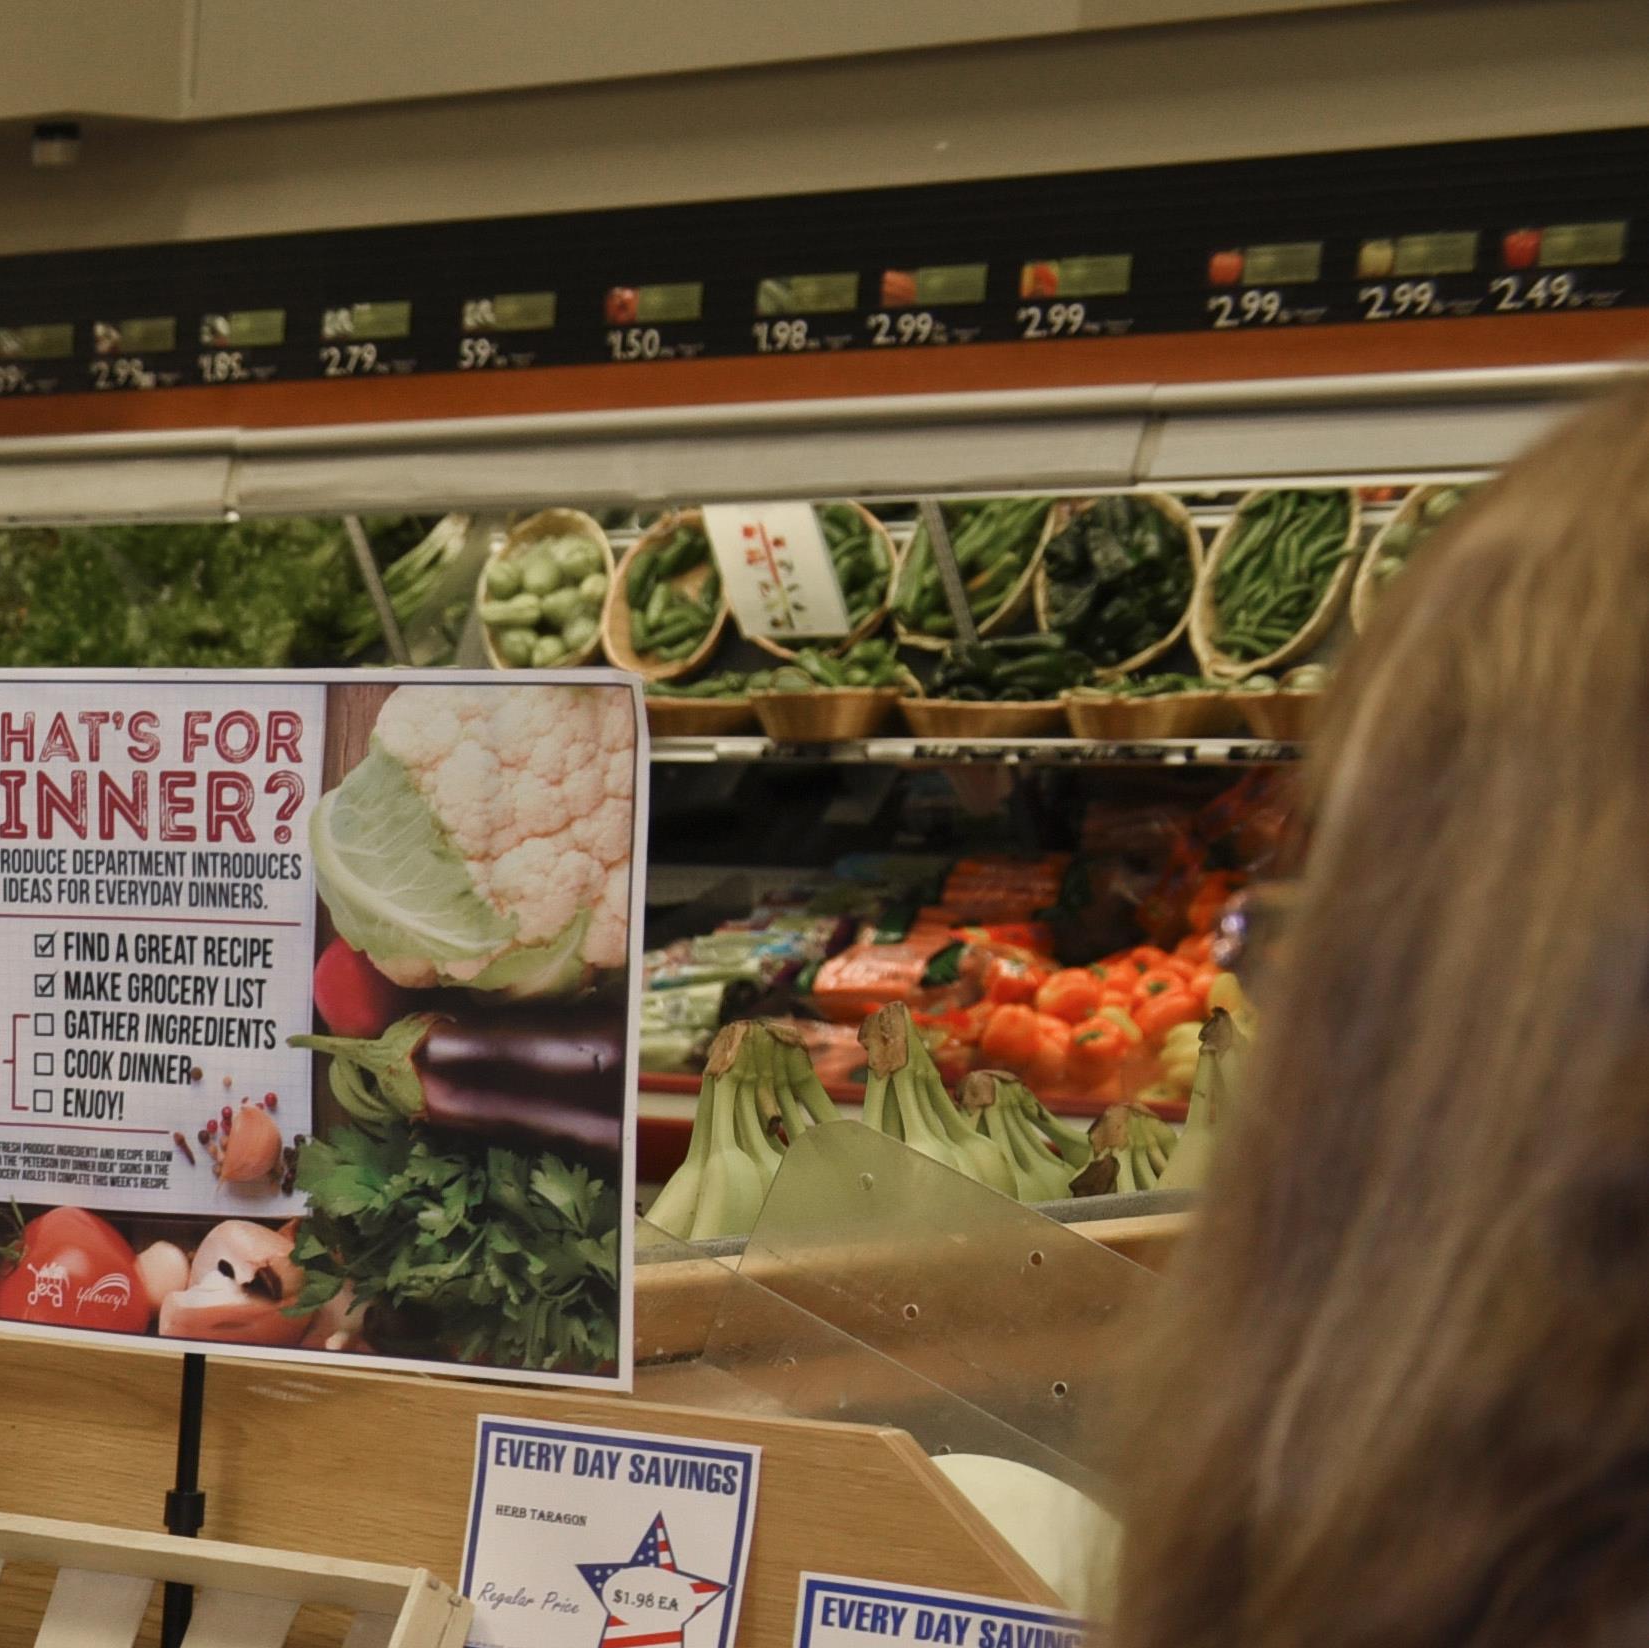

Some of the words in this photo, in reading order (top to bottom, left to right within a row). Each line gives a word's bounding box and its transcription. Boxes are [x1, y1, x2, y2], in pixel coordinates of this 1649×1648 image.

[182, 711, 303, 764] FOR
[72, 850, 186, 878] DEPARTMENT
[192, 852, 302, 880] INTRODUCES
[3, 878, 52, 902] IDEAS
[58, 879, 90, 905] FOR
[95, 880, 183, 907] EVERYDAY
[188, 883, 268, 909] DINNERS.
[64, 932, 109, 963] FIND
[115, 934, 128, 963] A
[135, 935, 197, 965] GREAT
[204, 937, 274, 969] RECIPE
[64, 972, 122, 1001] MAKE
[128, 973, 219, 1006] GROCERY
[224, 977, 267, 1009] LIST
[64, 1010, 139, 1043] GATHER
[145, 1014, 276, 1050] INGREDIENTS
[64, 1049, 112, 1081] COOK
[119, 1052, 192, 1085] DINNER
[63, 1088, 124, 1120] ENJOY!
[495, 1437, 567, 1473] EVERY
[573, 1447, 621, 1480] DAY
[628, 1454, 738, 1495] SAVINGS
[495, 1504, 527, 1518] HERB
[530, 1508, 587, 1526] TARAGON
[657, 1598, 679, 1612] EA
[821, 1596, 907, 1637] EVERY
[914, 1609, 971, 1646] DAY
